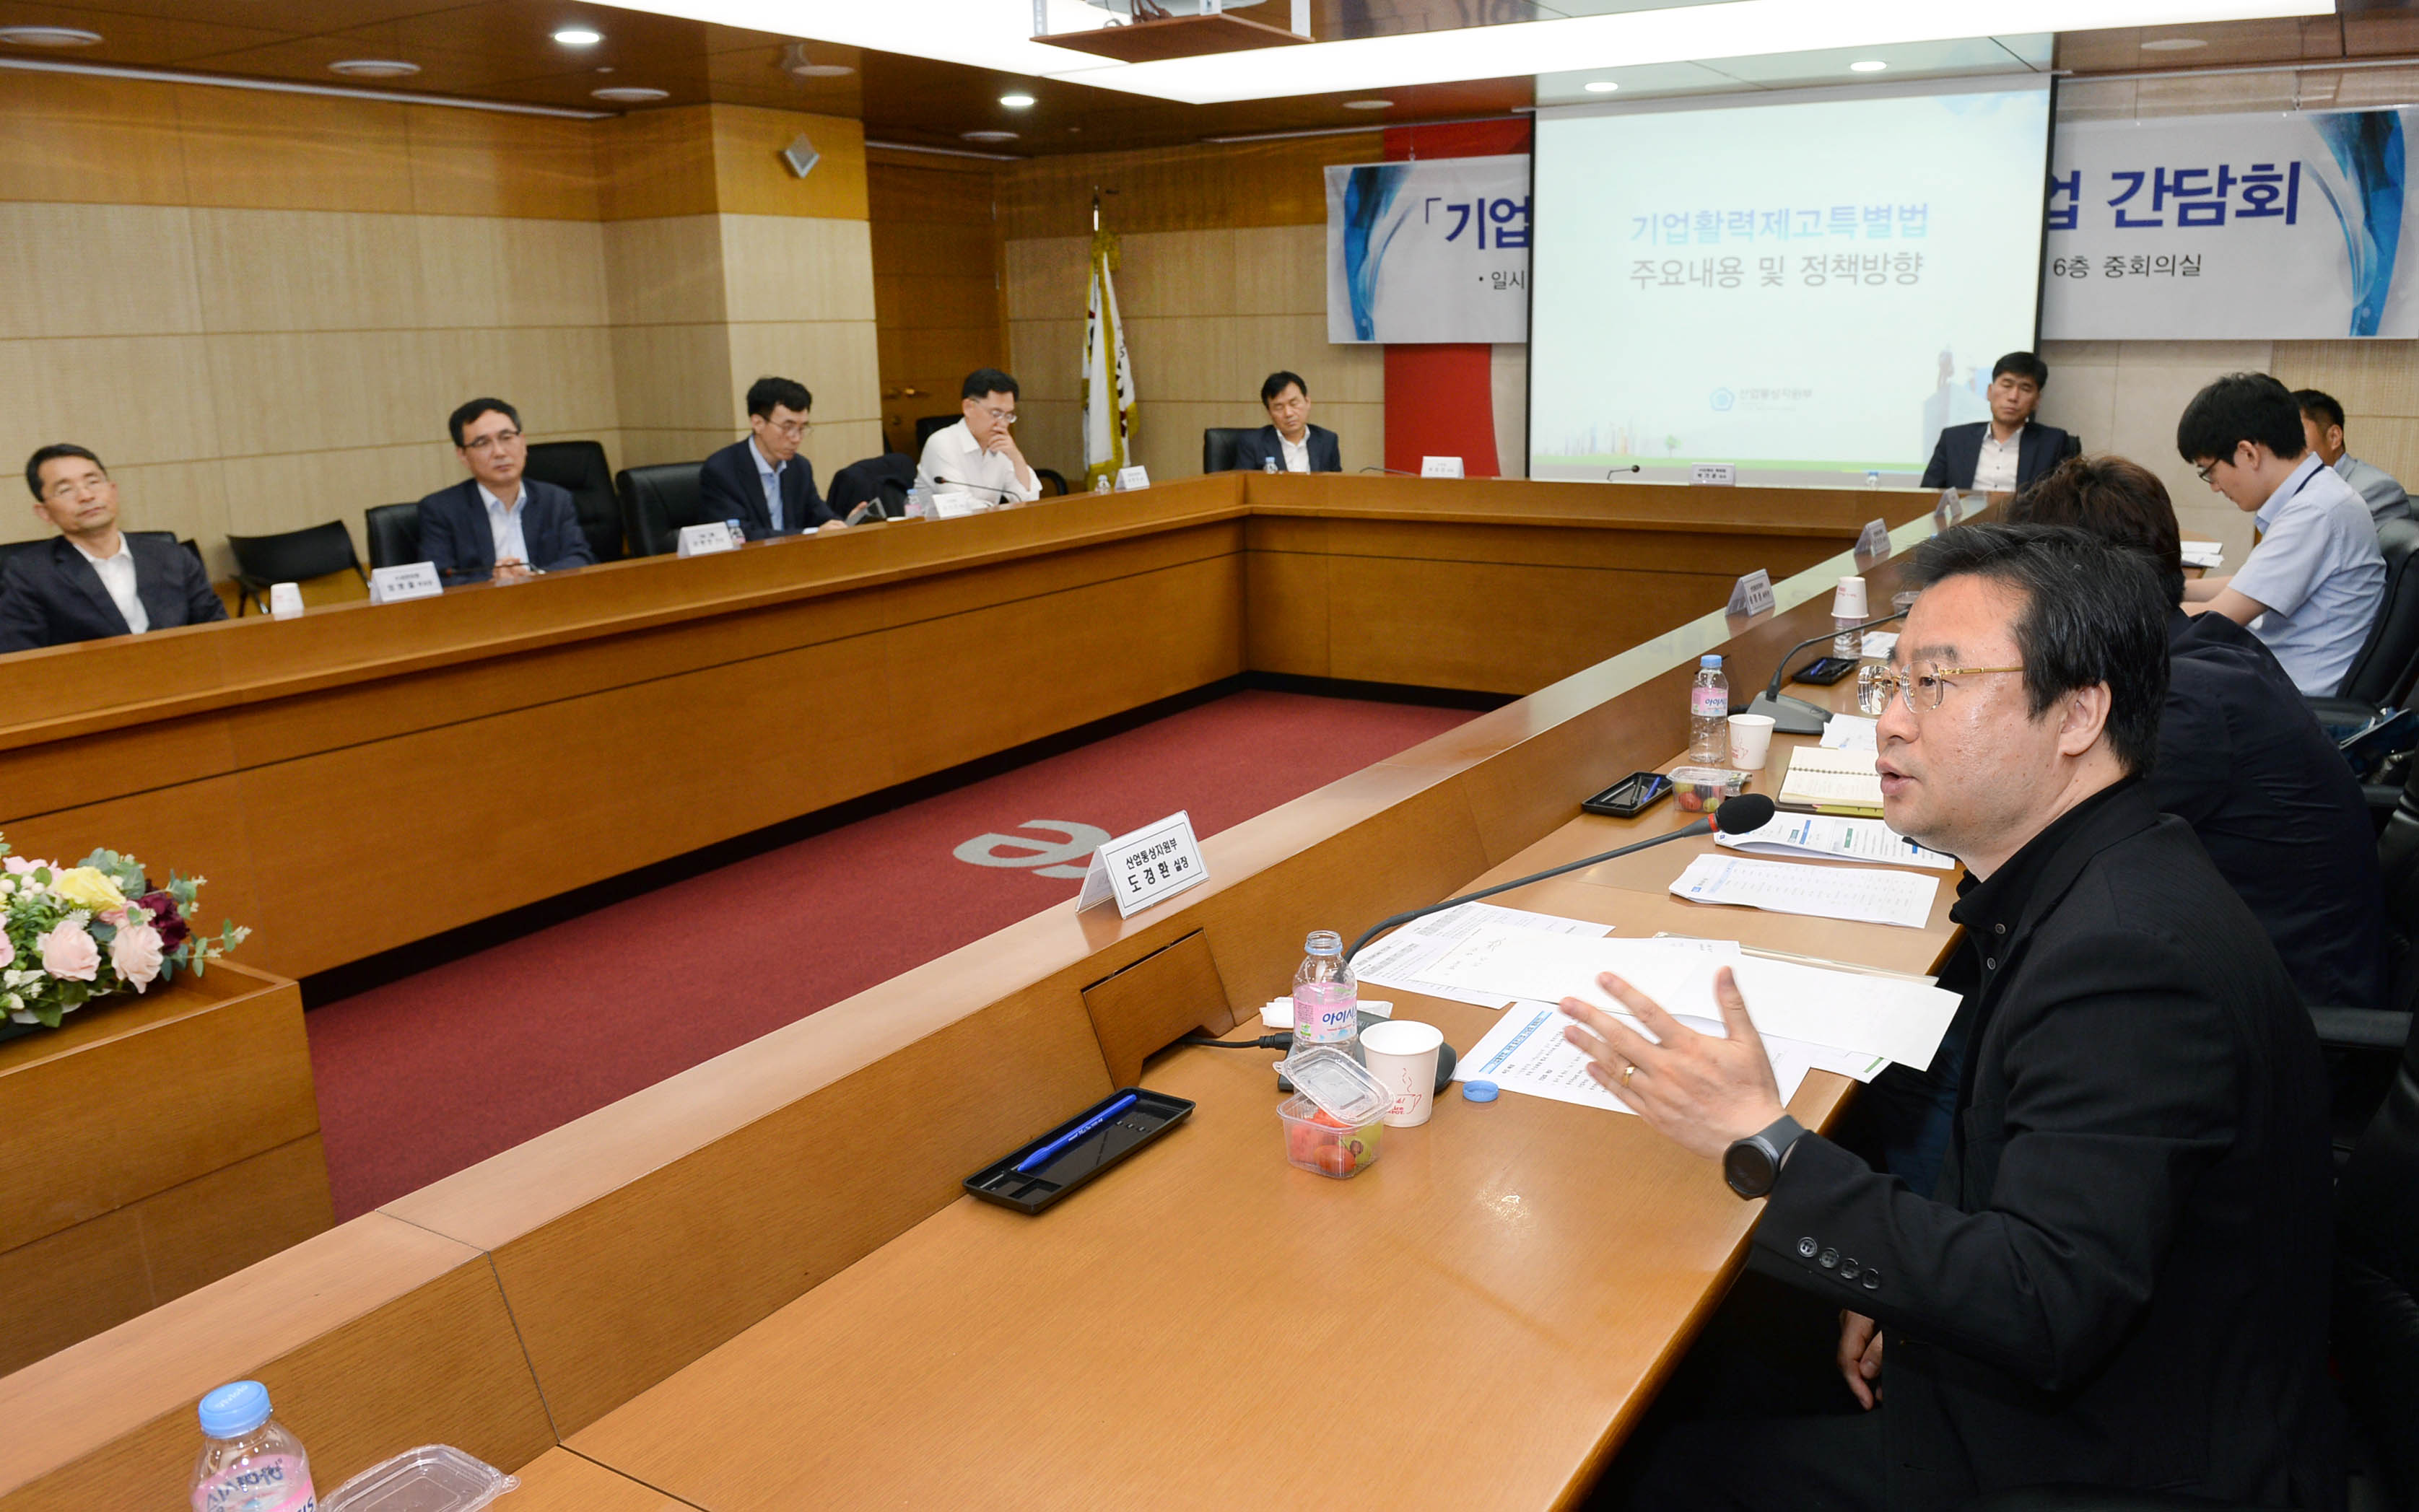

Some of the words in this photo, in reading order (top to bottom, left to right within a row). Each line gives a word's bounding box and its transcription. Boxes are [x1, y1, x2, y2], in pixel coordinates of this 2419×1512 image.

[2107, 161, 2301, 228] 간담회
[1630, 203, 1928, 245] 기업활력제고특별법
[1491, 271, 1525, 289] 일시
[1630, 255, 1744, 289] 주요내용
[1759, 255, 1784, 287] 및
[1800, 251, 1924, 287] 정책방향
[2053, 255, 2090, 279] 6층
[2104, 254, 2201, 278] 중회의실
[1125, 838, 1177, 870] 산업통상자원부
[1173, 856, 1189, 872] 실장
